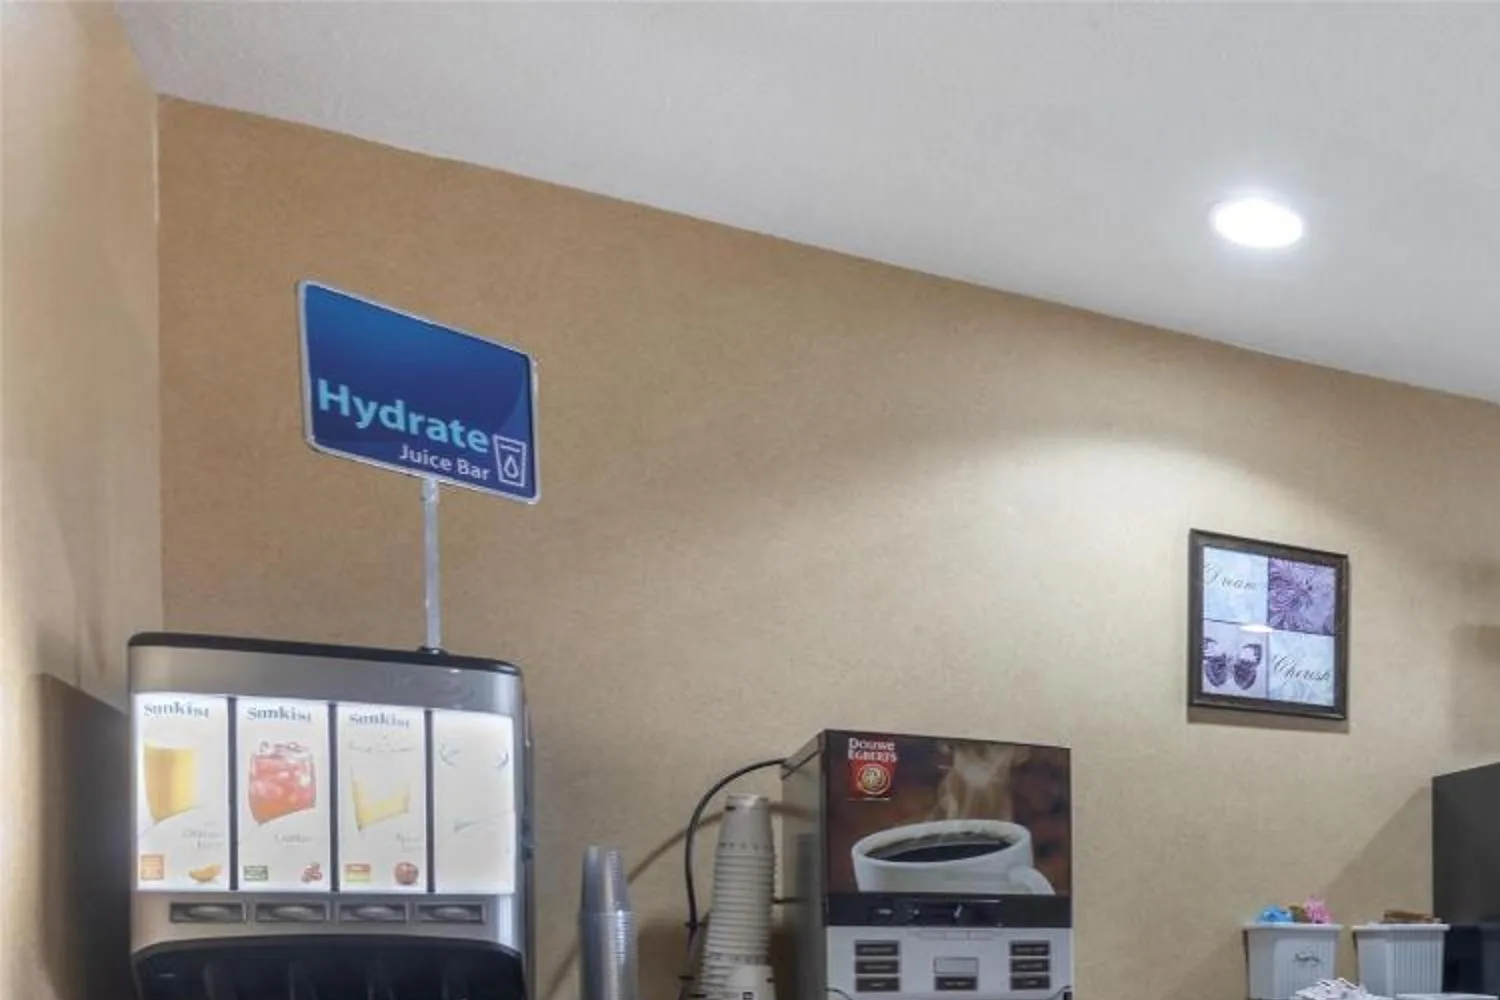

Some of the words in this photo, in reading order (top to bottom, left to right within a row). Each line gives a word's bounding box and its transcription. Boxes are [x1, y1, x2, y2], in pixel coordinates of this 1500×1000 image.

[317, 377, 490, 453] Hydrate
[399, 443, 452, 471] Juice
[456, 458, 491, 480] Bar
[144, 701, 210, 719] Sunkist
[247, 705, 312, 721] Sunkist
[350, 711, 410, 729] Sunkist
